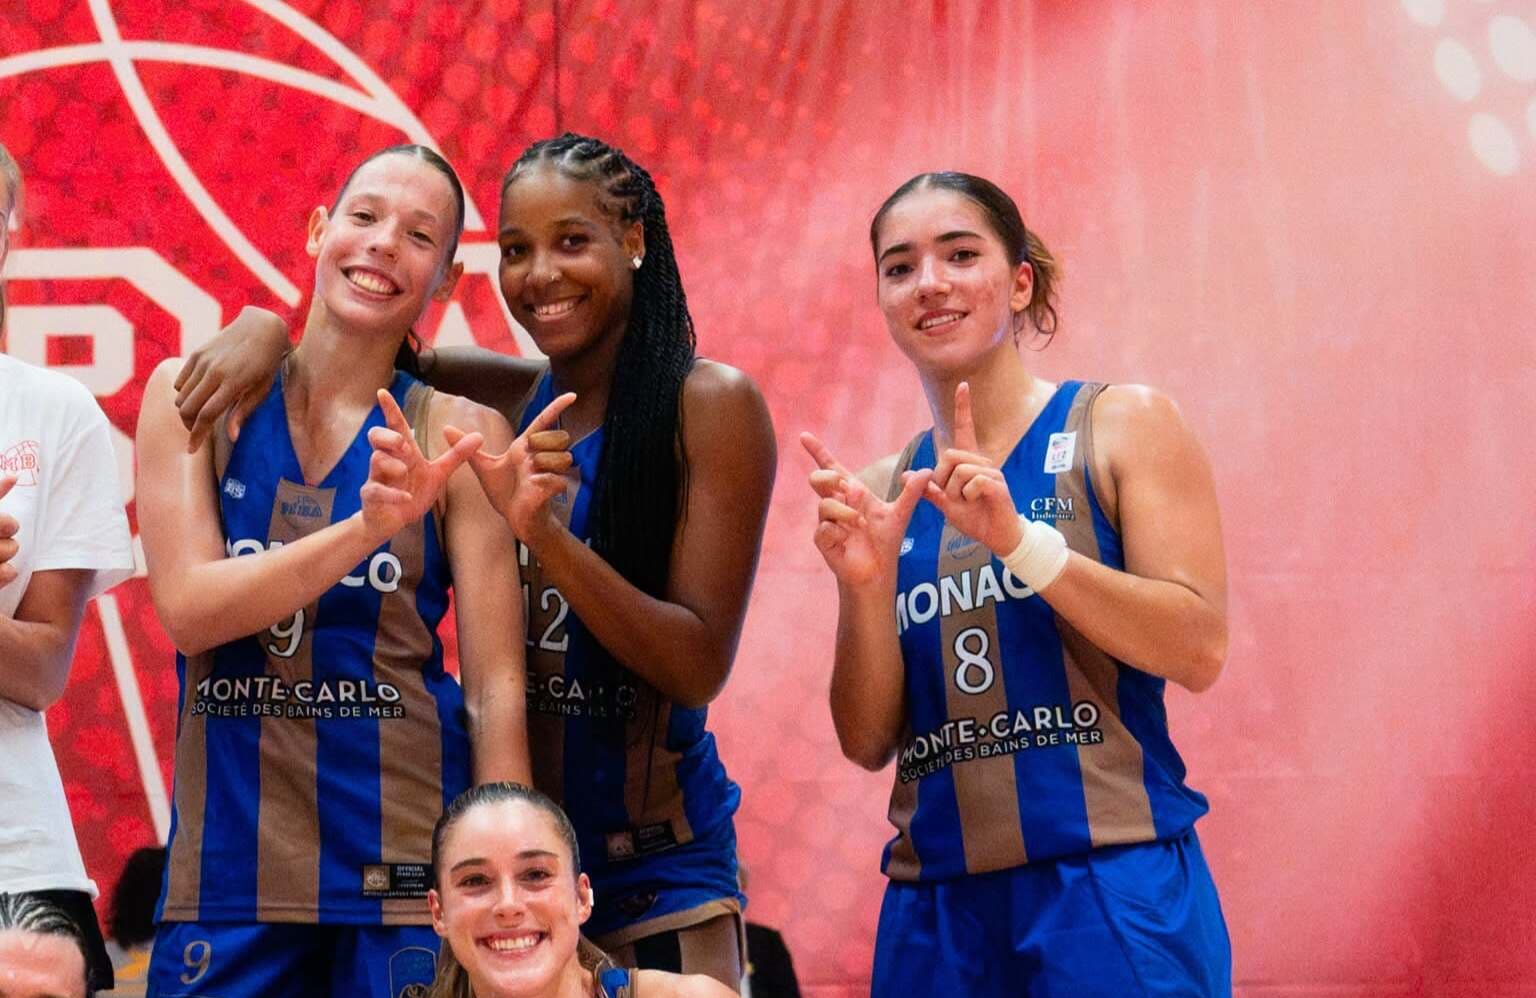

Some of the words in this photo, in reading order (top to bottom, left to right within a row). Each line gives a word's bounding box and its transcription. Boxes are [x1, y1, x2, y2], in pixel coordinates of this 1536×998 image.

[1031, 497, 1073, 511] CFM
[896, 563, 1035, 637] MONAC
[268, 607, 305, 658] 9
[954, 627, 996, 695] 8
[253, 703, 281, 717] DES
[288, 704, 332, 718] BAINS
[340, 706, 360, 717] DE
[369, 707, 403, 718] MER
[945, 747, 974, 763] DES
[980, 737, 1029, 757] BAINS
[1037, 733, 1059, 746] DE
[1066, 731, 1102, 743] MER
[180, 940, 212, 985] 9
